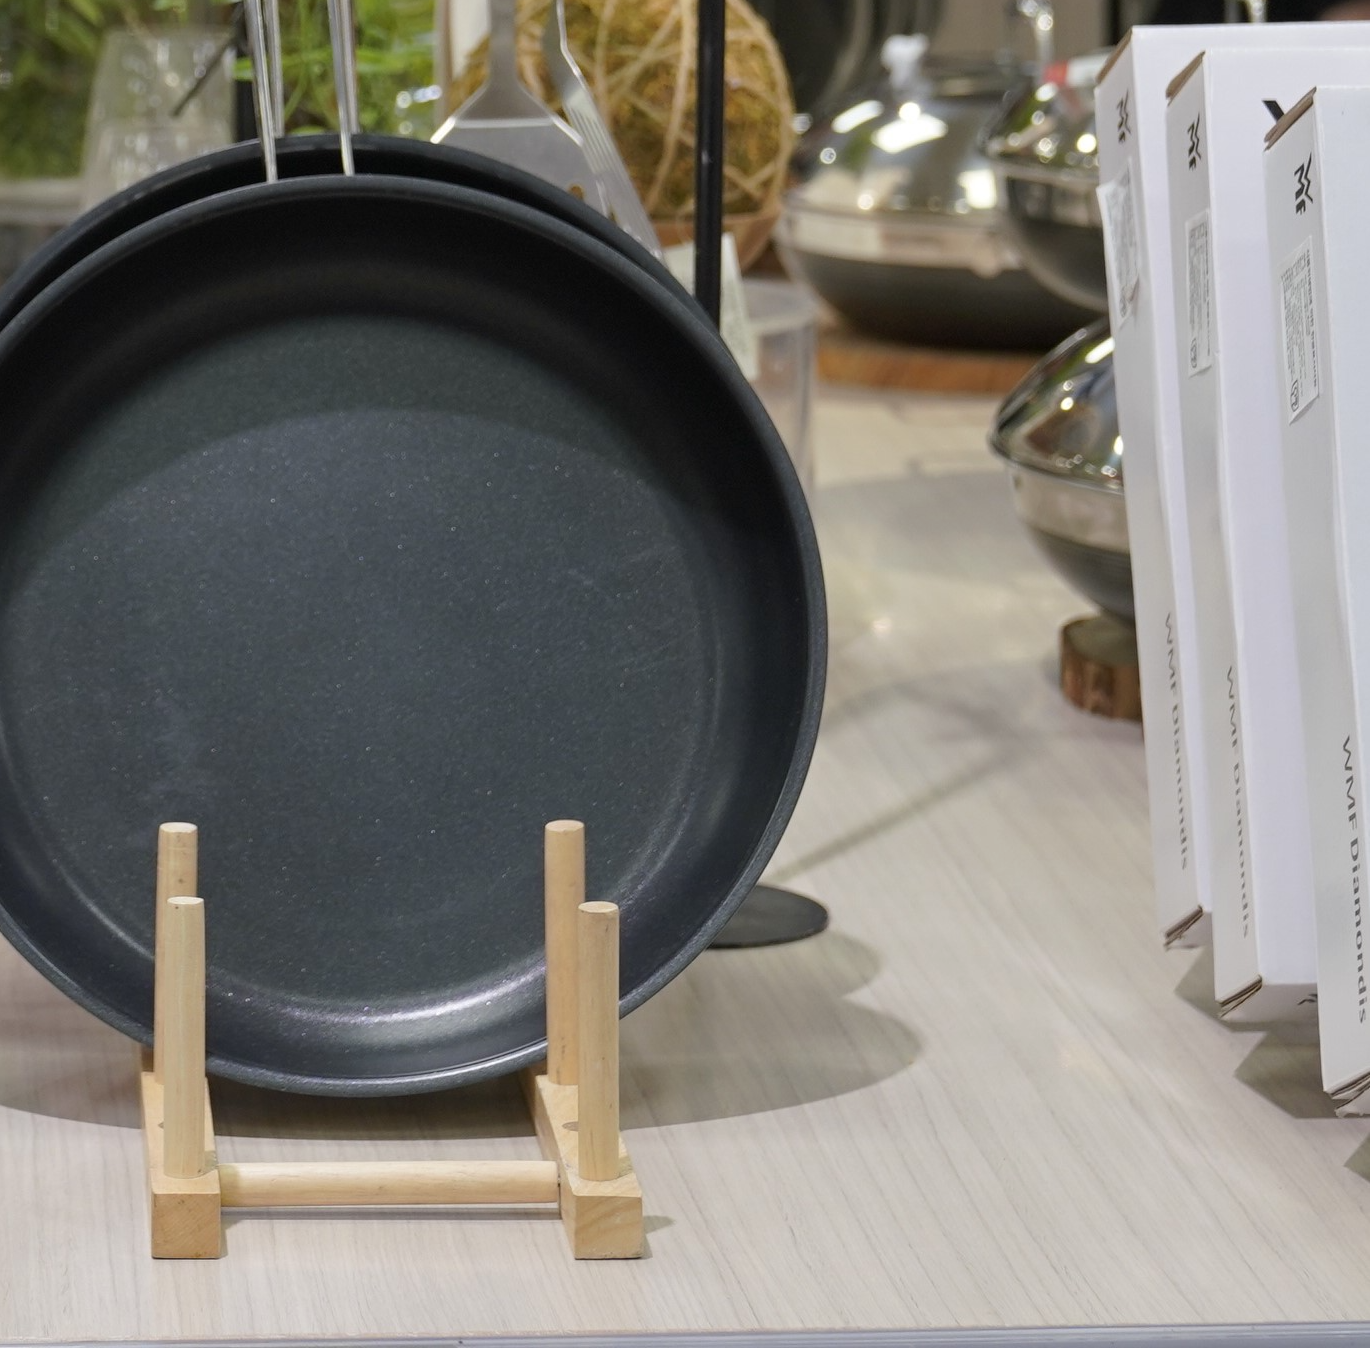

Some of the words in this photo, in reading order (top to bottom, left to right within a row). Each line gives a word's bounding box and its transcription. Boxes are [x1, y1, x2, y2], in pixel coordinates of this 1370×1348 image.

[1165, 612, 1178, 695] WMF
[1226, 665, 1239, 748] WMF
[1341, 735, 1358, 832] WMF
[1349, 838, 1368, 1026] Diamondis
